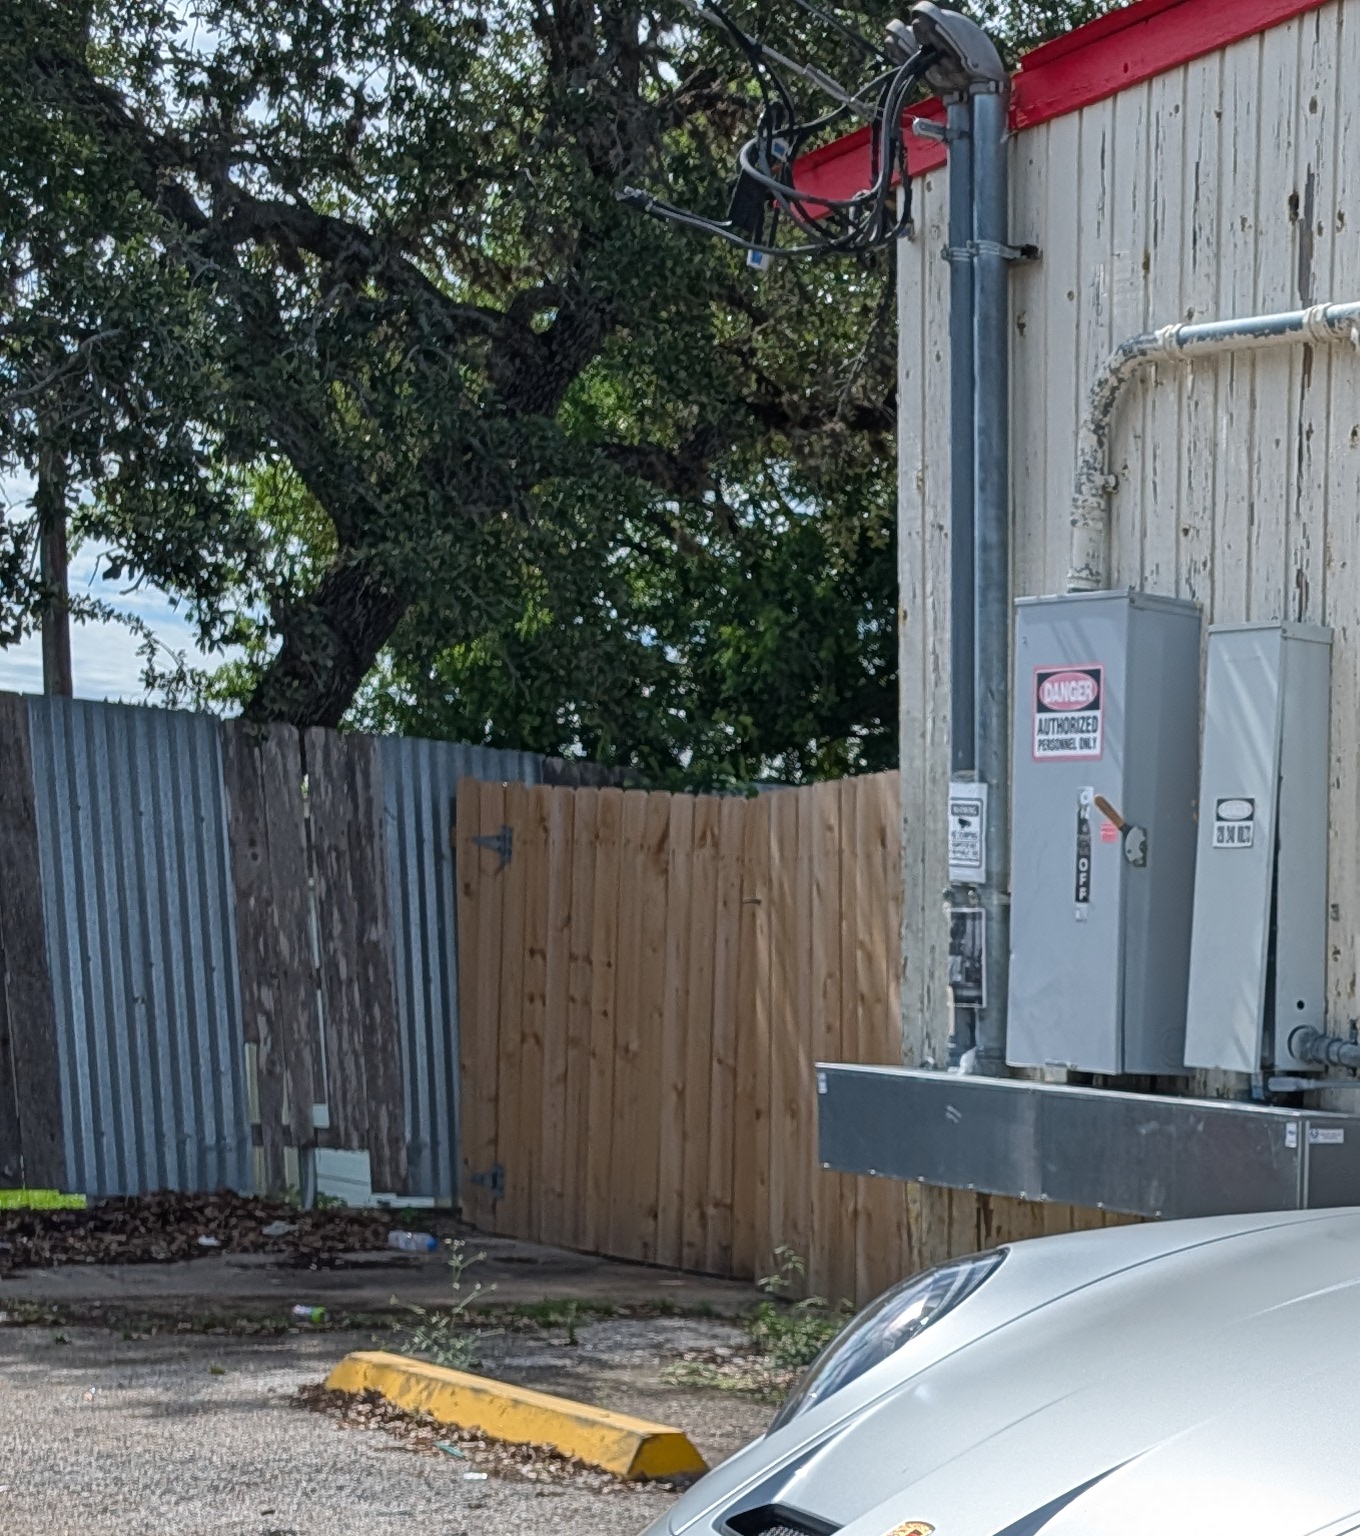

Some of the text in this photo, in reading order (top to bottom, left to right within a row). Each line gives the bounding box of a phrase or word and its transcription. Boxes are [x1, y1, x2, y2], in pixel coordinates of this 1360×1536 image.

[1044, 680, 1092, 702] DANGER
[1037, 715, 1098, 736] AUTHORIZED
[1038, 736, 1097, 751] PERSONNEL ONLY
[1079, 858, 1088, 900] OFF
